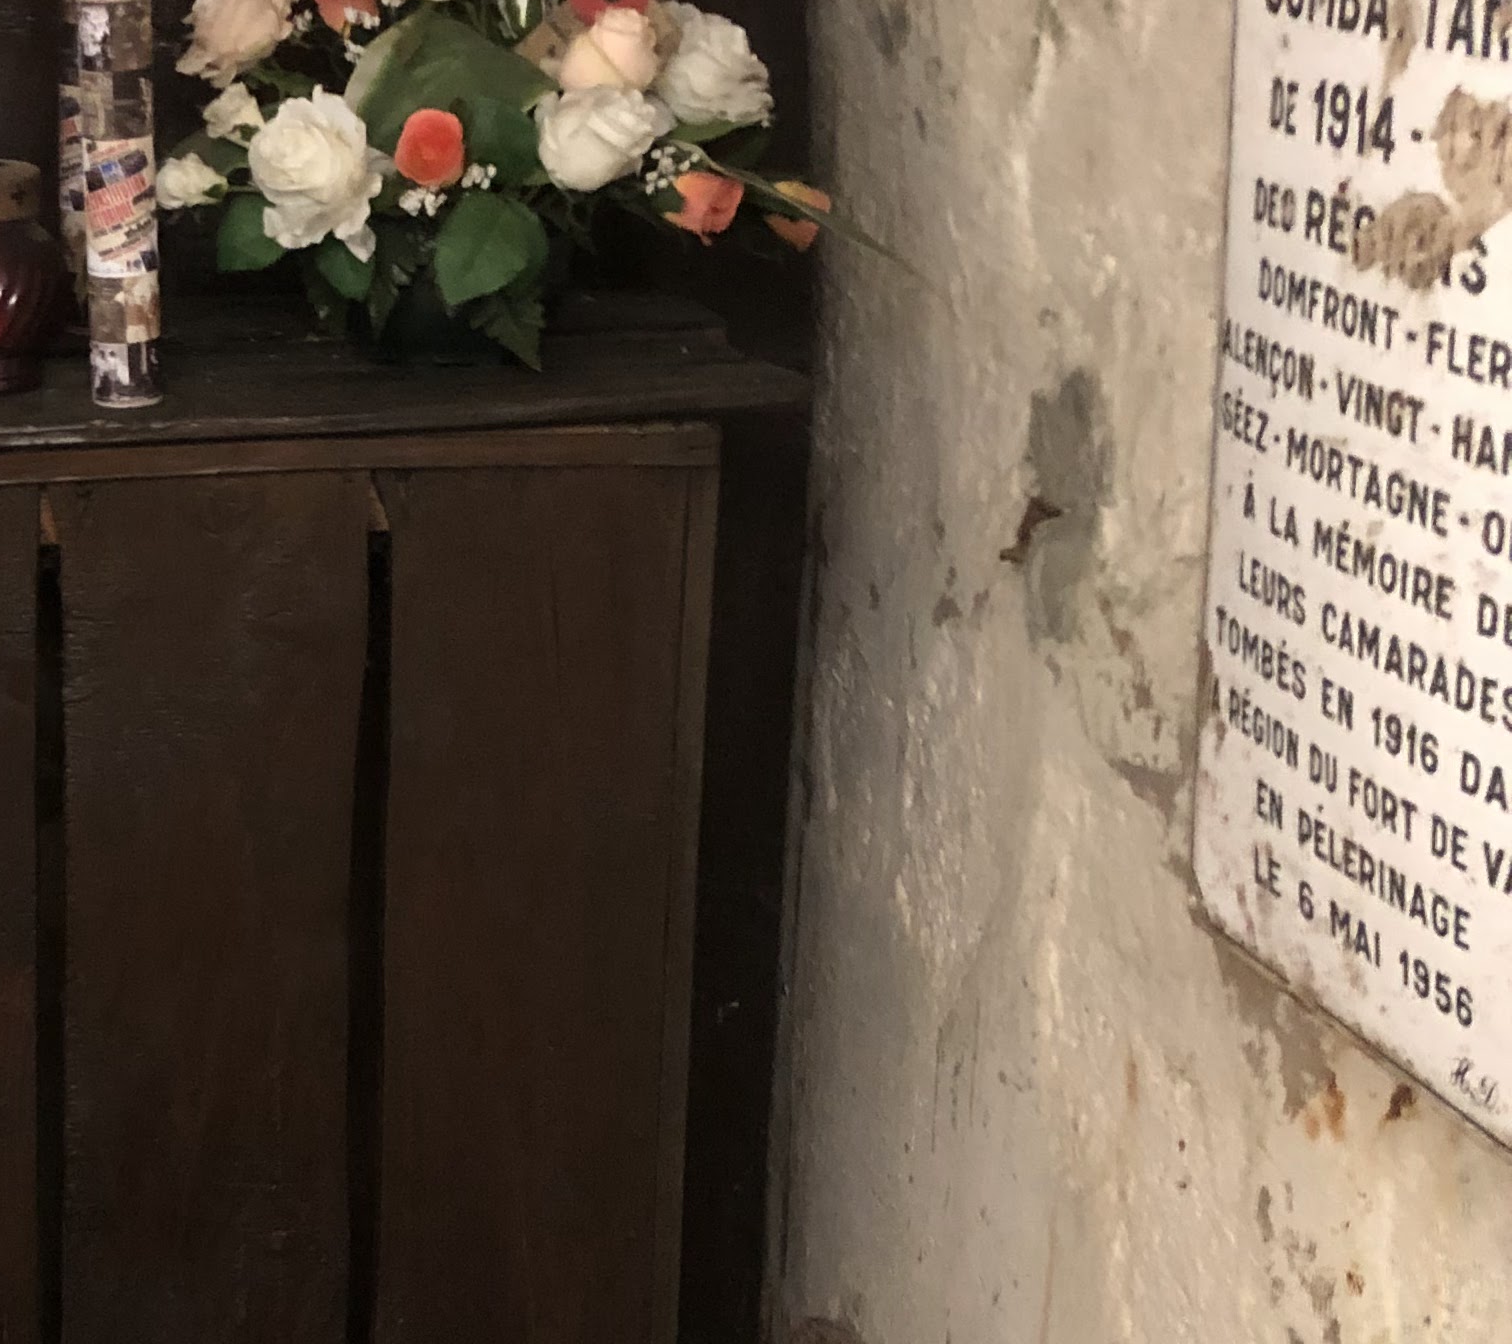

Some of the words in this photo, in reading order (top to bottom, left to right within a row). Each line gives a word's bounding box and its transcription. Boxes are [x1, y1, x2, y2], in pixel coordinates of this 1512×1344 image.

[1269, 76, 1299, 136] DE
[1313, 78, 1395, 164] 1914
[1257, 256, 1399, 350] DOMFRONT
[1222, 318, 1314, 401] ALENÇON
[1336, 370, 1425, 444] VINGT
[1286, 426, 1451, 538] MORTAGNE
[1239, 550, 1306, 627] LEURS
[1269, 496, 1299, 547] LA
[1312, 519, 1456, 621] MÉMOIRE
[1216, 605, 1307, 701] TOMBÉS
[1321, 677, 1354, 732] EN
[1372, 707, 1439, 775] 1916
[1228, 687, 1299, 771] RÉGION
[1308, 742, 1337, 794] DU
[1348, 766, 1418, 842] FORT
[1431, 812, 1468, 872] DE
[1256, 778, 1283, 830] EN
[1254, 843, 1281, 898] LE
[1298, 879, 1314, 920] 6
[1330, 900, 1381, 969] MAI
[1399, 950, 1474, 1027] 1956
